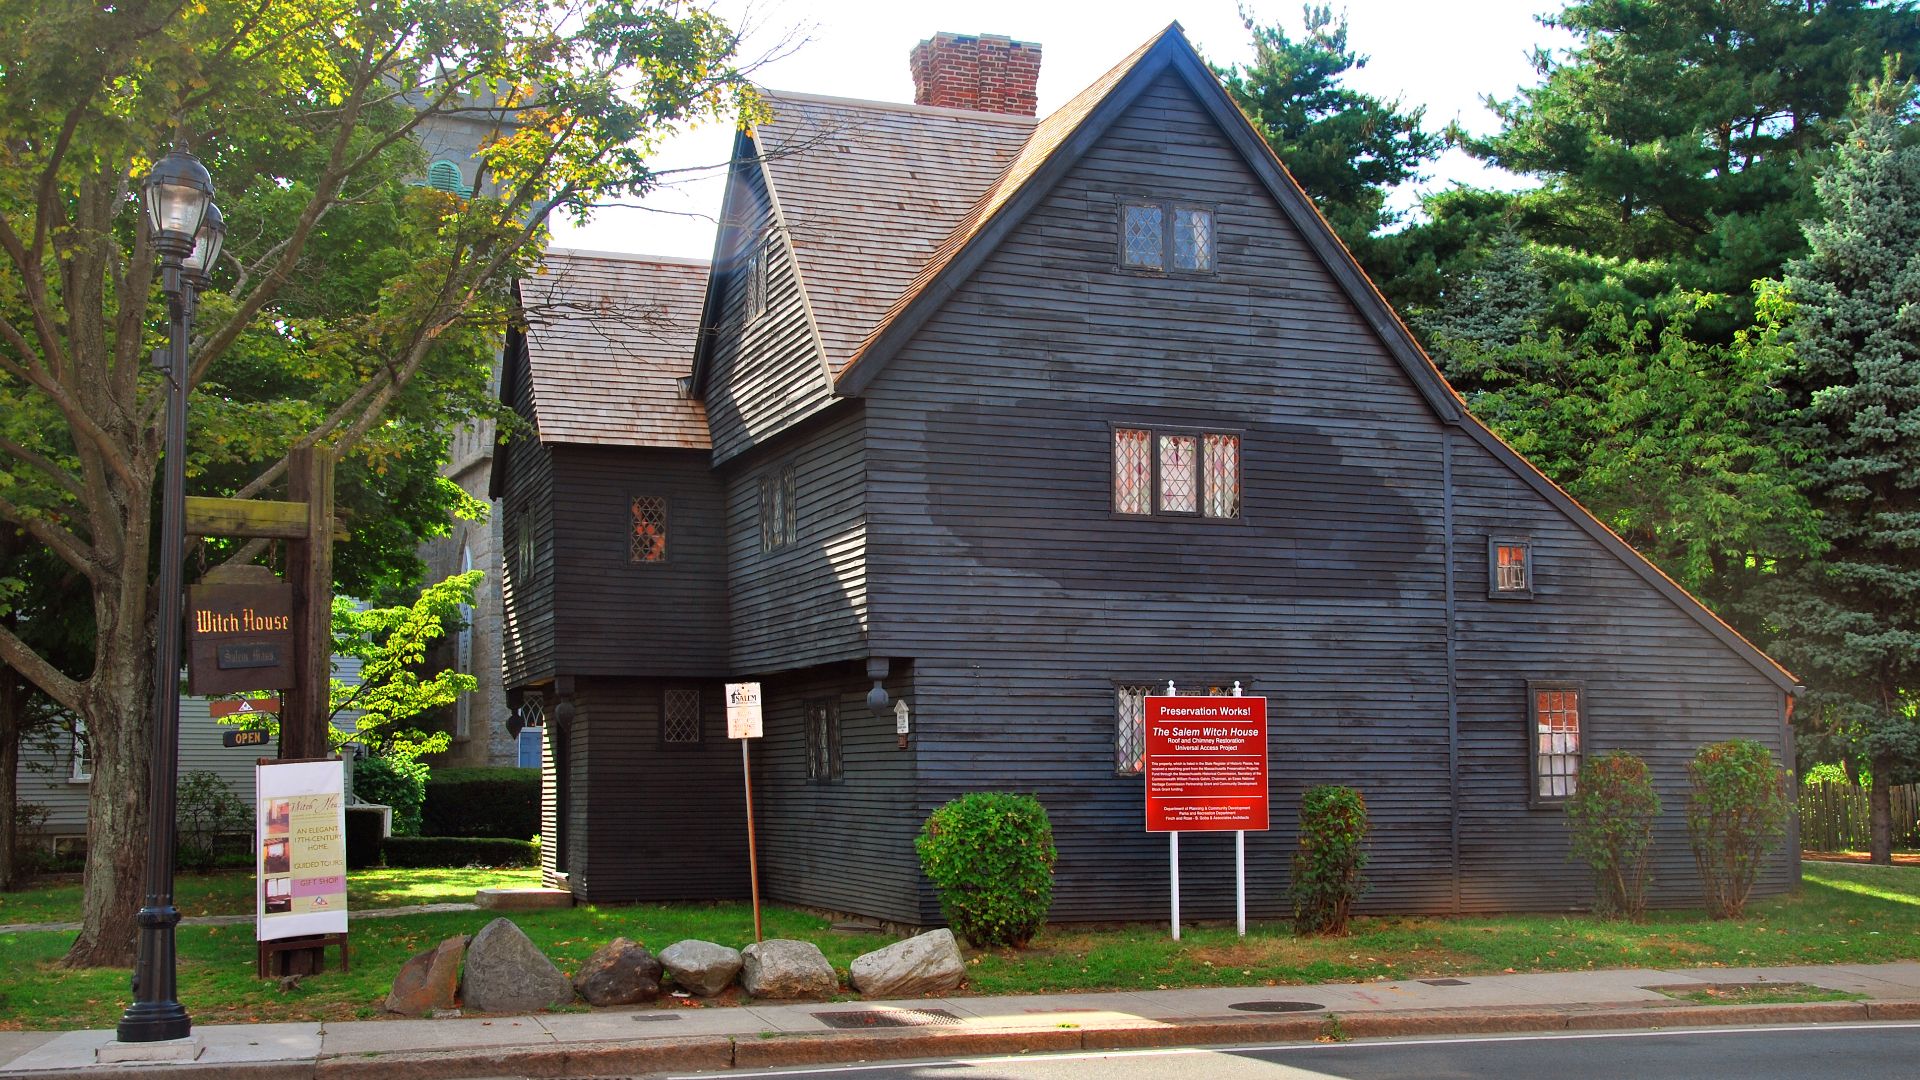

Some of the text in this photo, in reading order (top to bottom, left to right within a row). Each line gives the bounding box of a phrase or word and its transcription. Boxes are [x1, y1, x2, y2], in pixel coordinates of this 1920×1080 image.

[196, 608, 288, 632] Witch House
[1160, 706, 1251, 716] Preservation Works!
[1153, 728, 1258, 736] The Salem Witch House
[235, 732, 260, 744] OPEN
